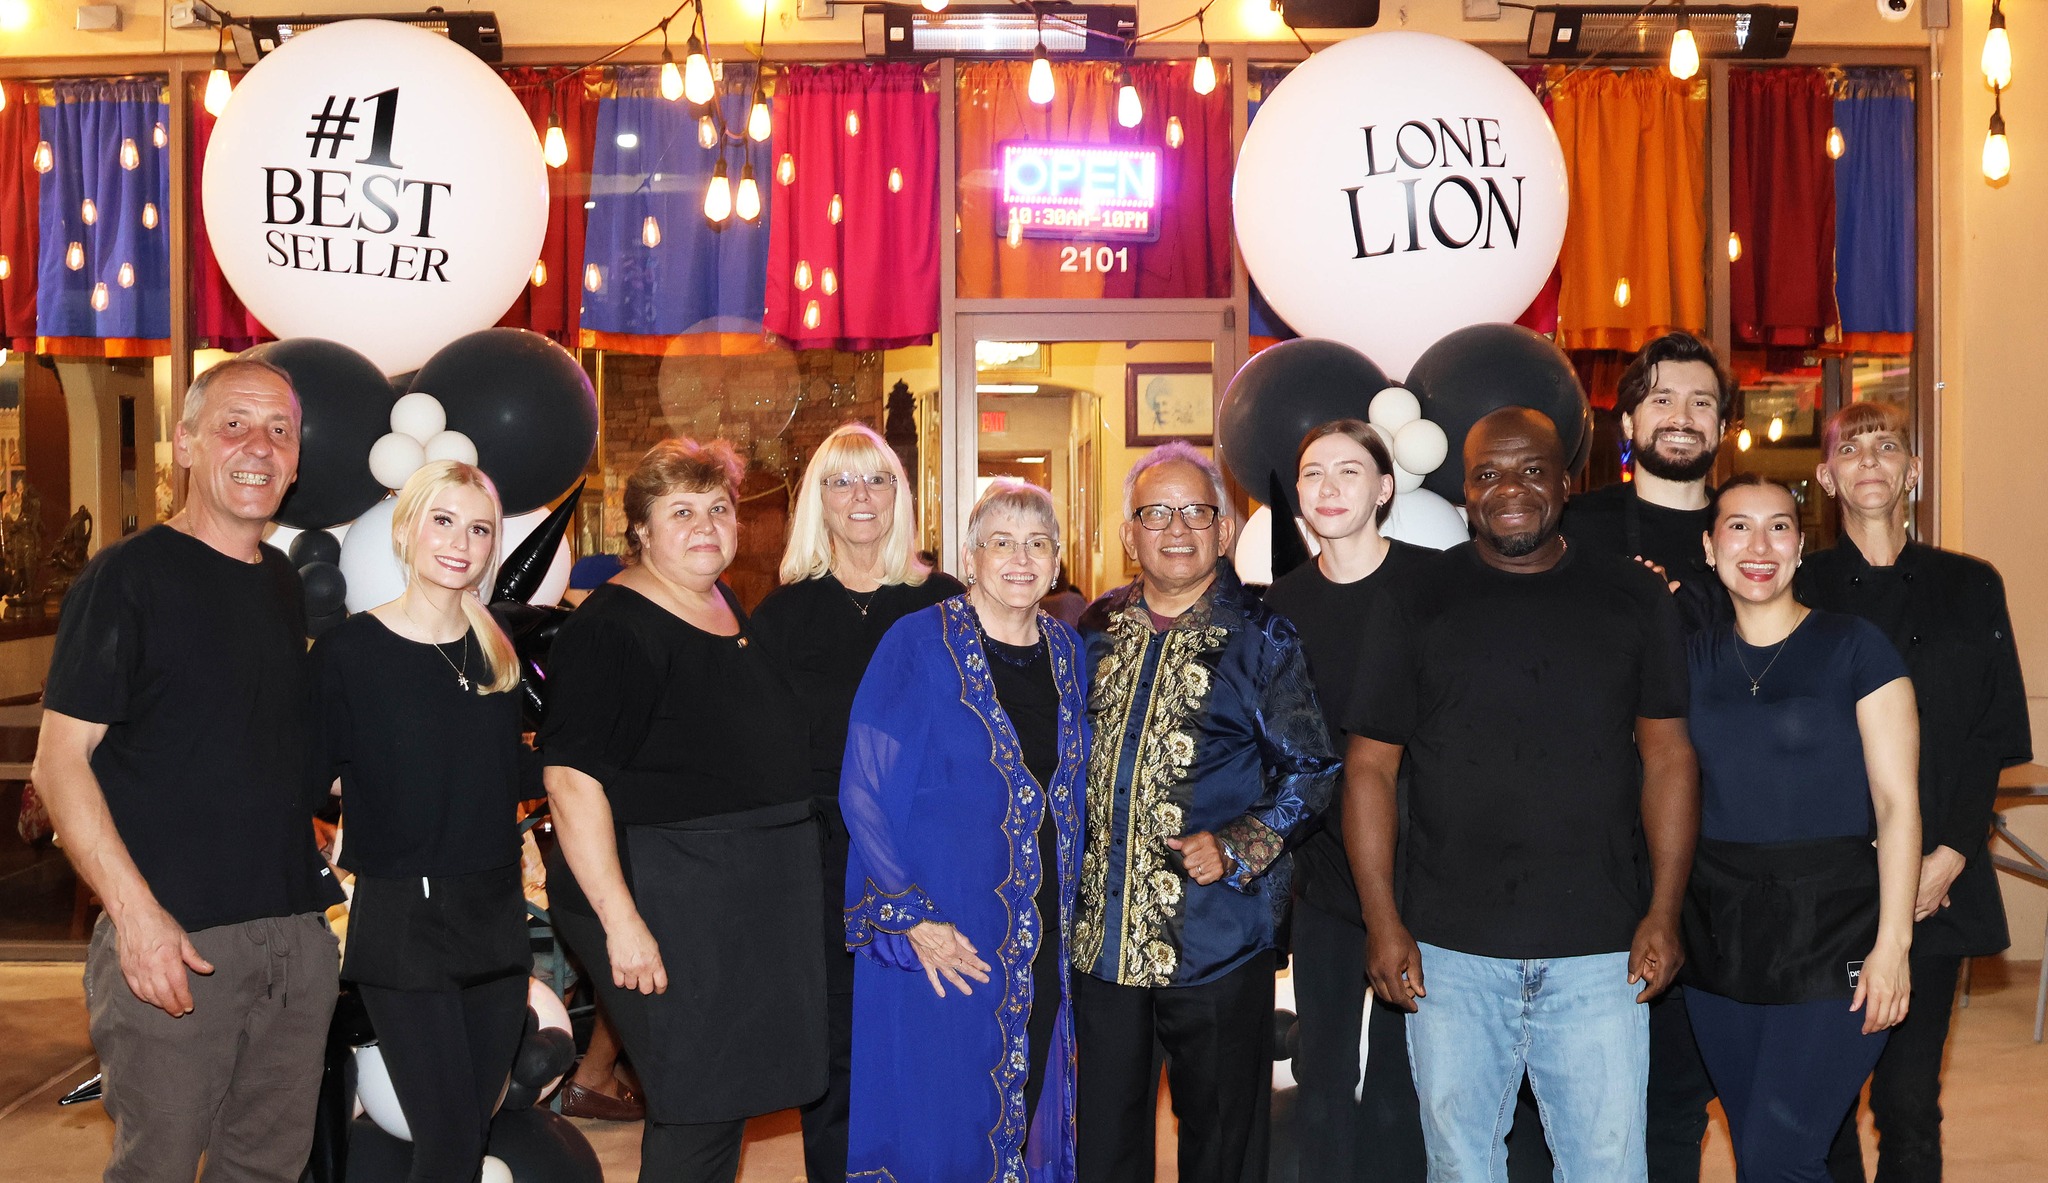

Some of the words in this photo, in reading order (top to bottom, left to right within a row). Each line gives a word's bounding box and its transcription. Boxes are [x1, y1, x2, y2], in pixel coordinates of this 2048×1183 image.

[306, 87, 403, 169] #1
[1360, 117, 1506, 177] LONE
[261, 167, 451, 238] BEST
[1010, 155, 1150, 200] OPEN
[1341, 175, 1526, 259] LION
[265, 229, 451, 282] SELLER
[1060, 246, 1128, 273] 2101
[981, 411, 1006, 433] EXIT
